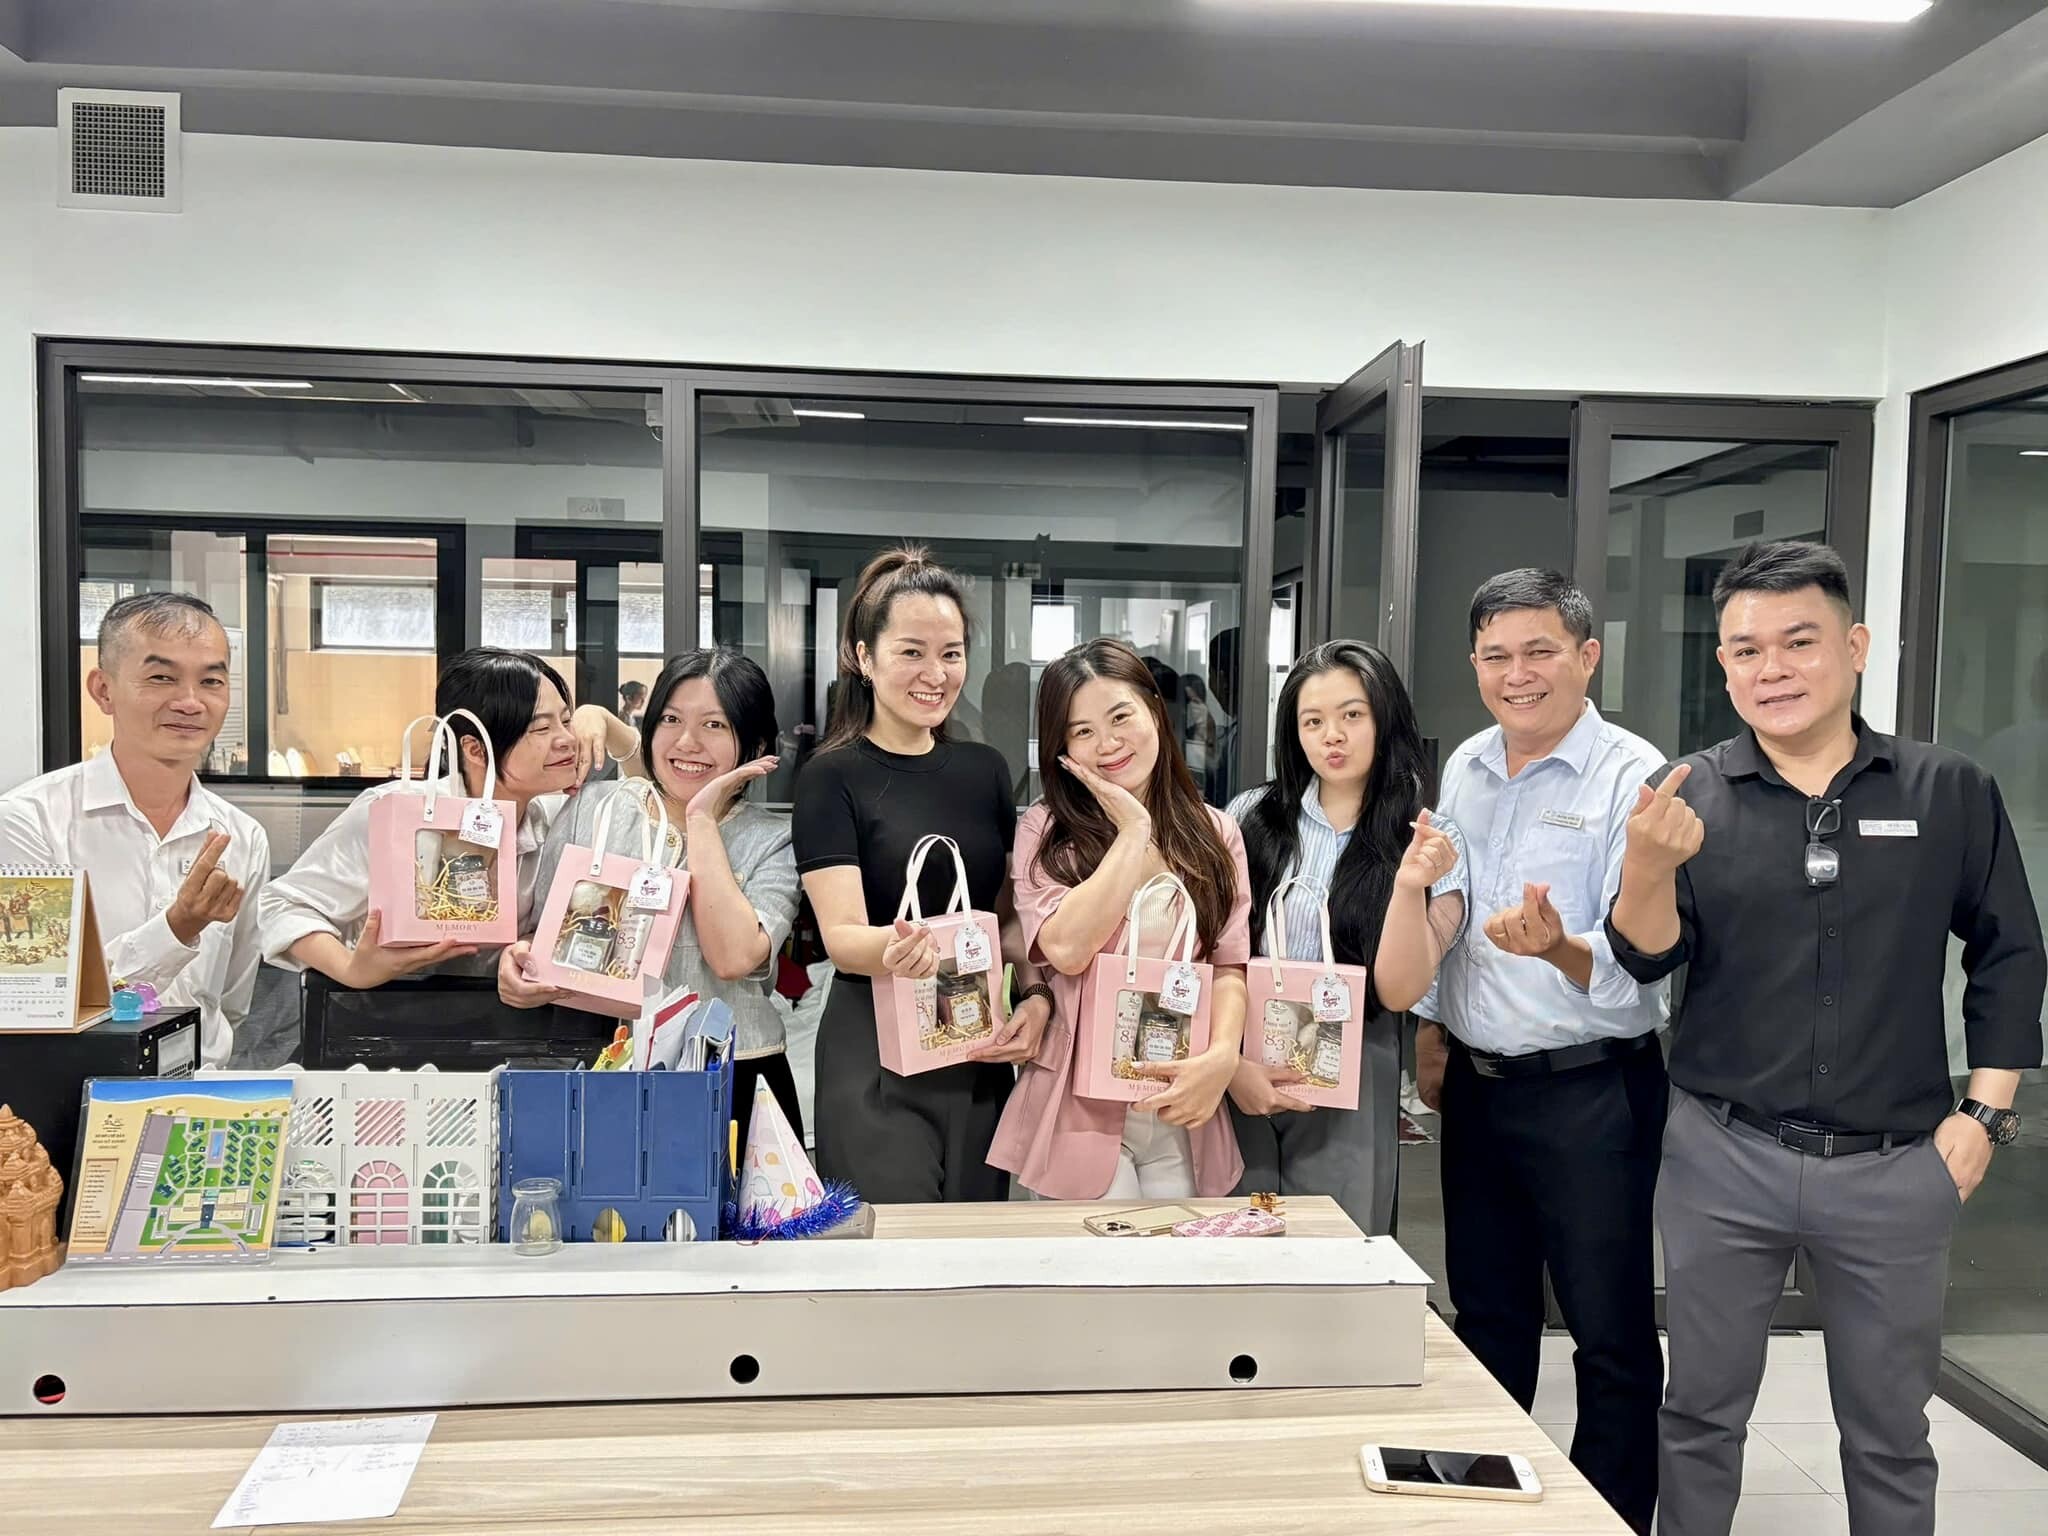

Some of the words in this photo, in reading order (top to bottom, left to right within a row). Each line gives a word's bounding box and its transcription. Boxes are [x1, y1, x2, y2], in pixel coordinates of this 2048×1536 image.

[435, 923, 479, 932] MEMORY
[617, 931, 636, 949] 8.3
[1264, 1034, 1285, 1051] 8.3
